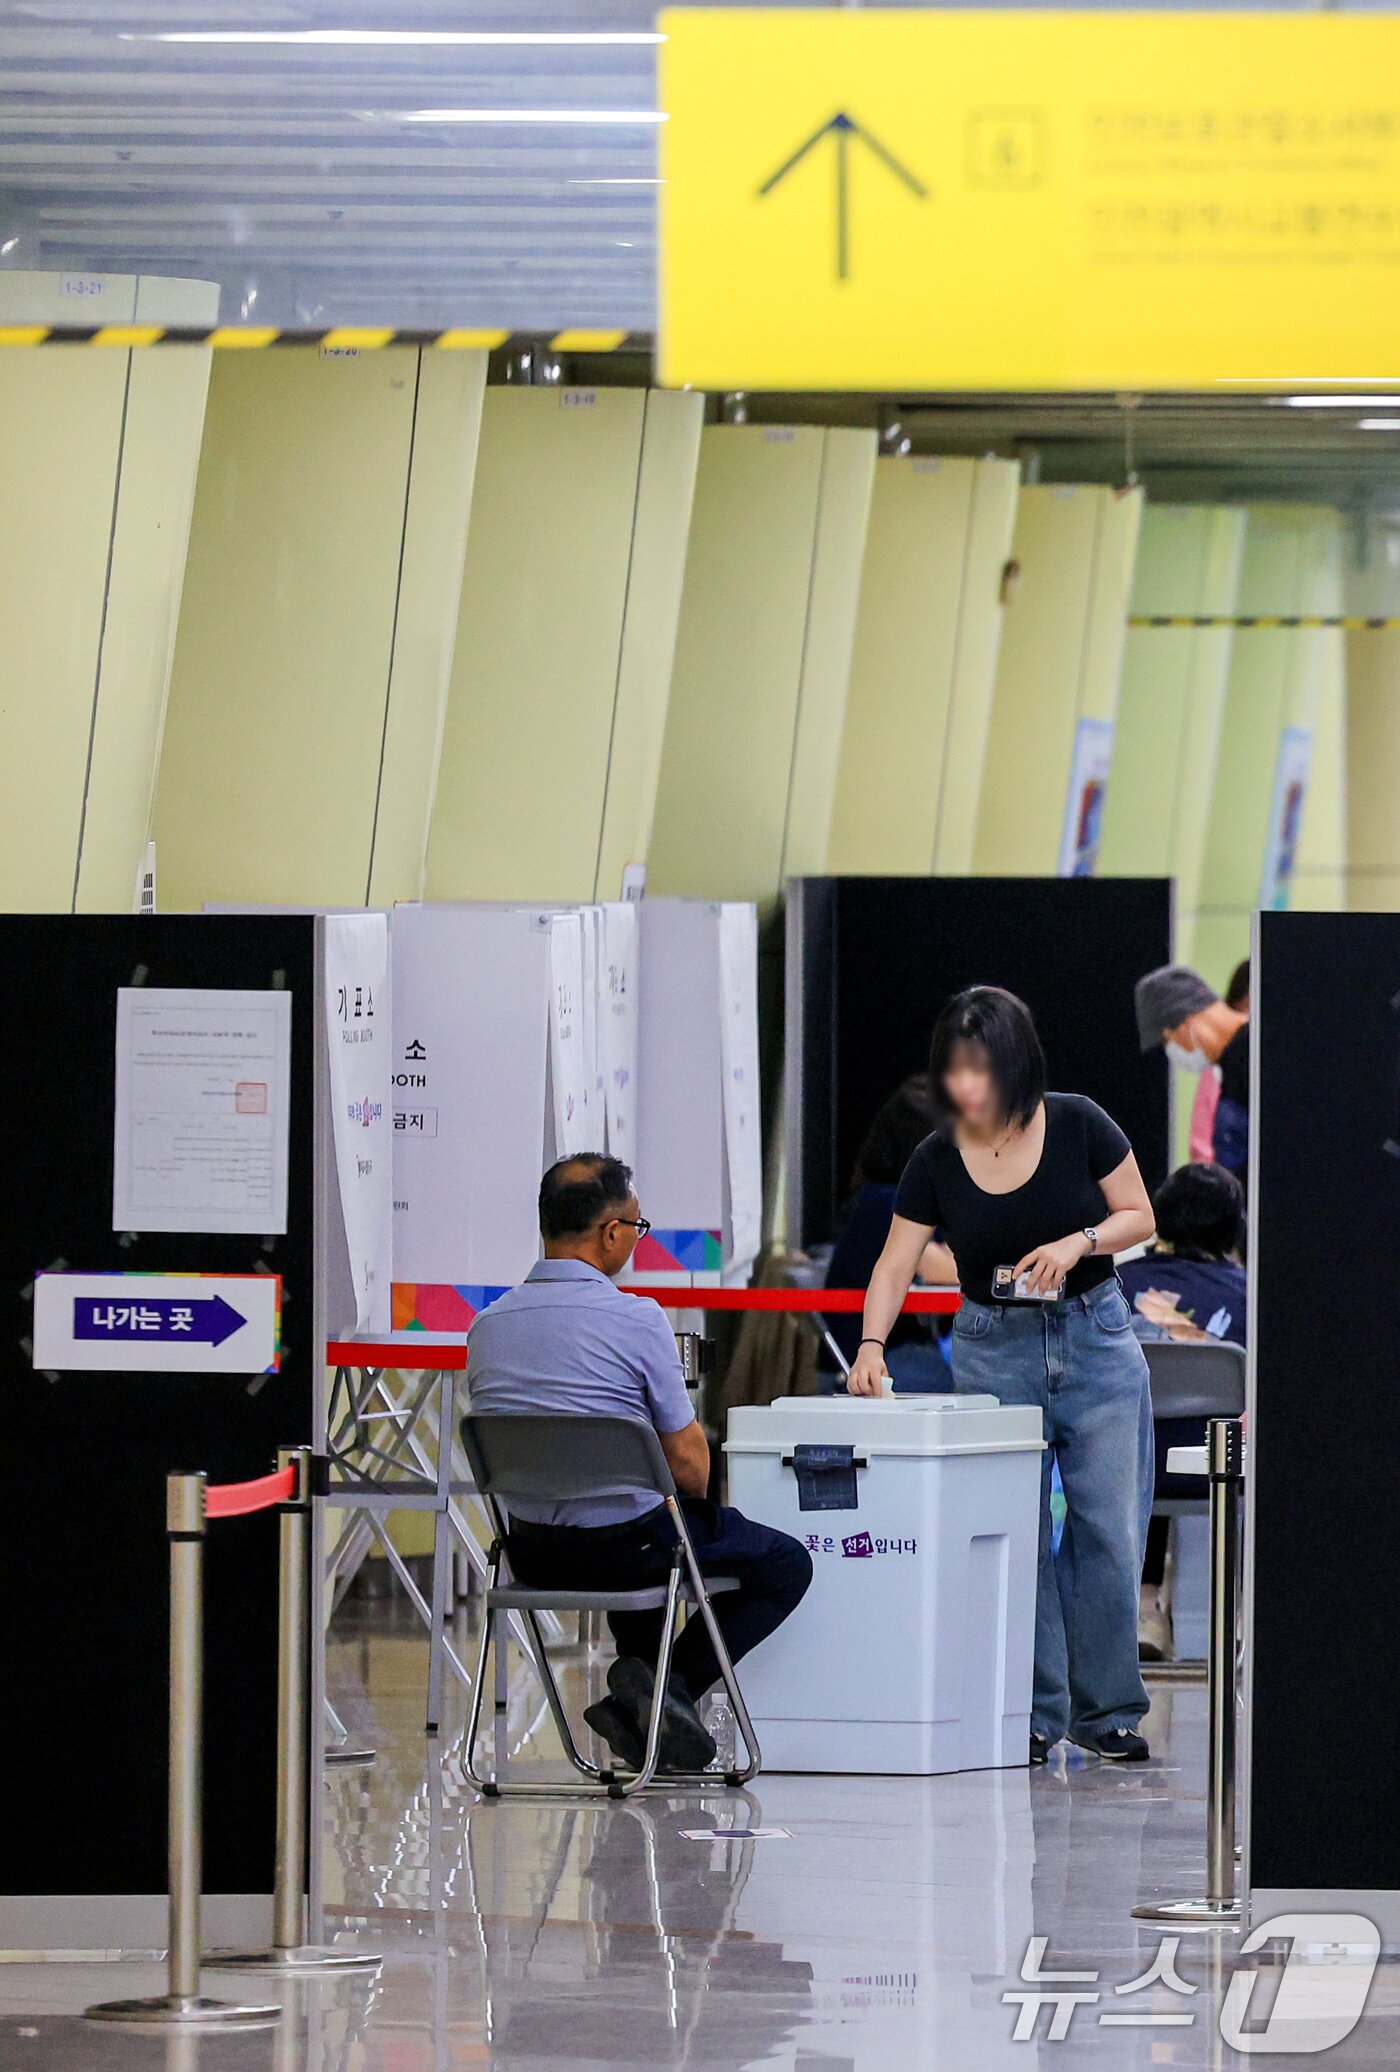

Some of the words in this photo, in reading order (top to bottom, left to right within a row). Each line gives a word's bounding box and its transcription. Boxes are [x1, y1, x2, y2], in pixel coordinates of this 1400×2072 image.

[338, 984, 374, 1022] 기표소
[405, 1039, 427, 1060] 소
[392, 1113, 424, 1130] 금지
[93, 1306, 162, 1331] 나가는
[169, 1307, 194, 1331] 곳
[805, 1534, 835, 1553] 꽃은
[841, 1531, 917, 1558] 선거입니다
